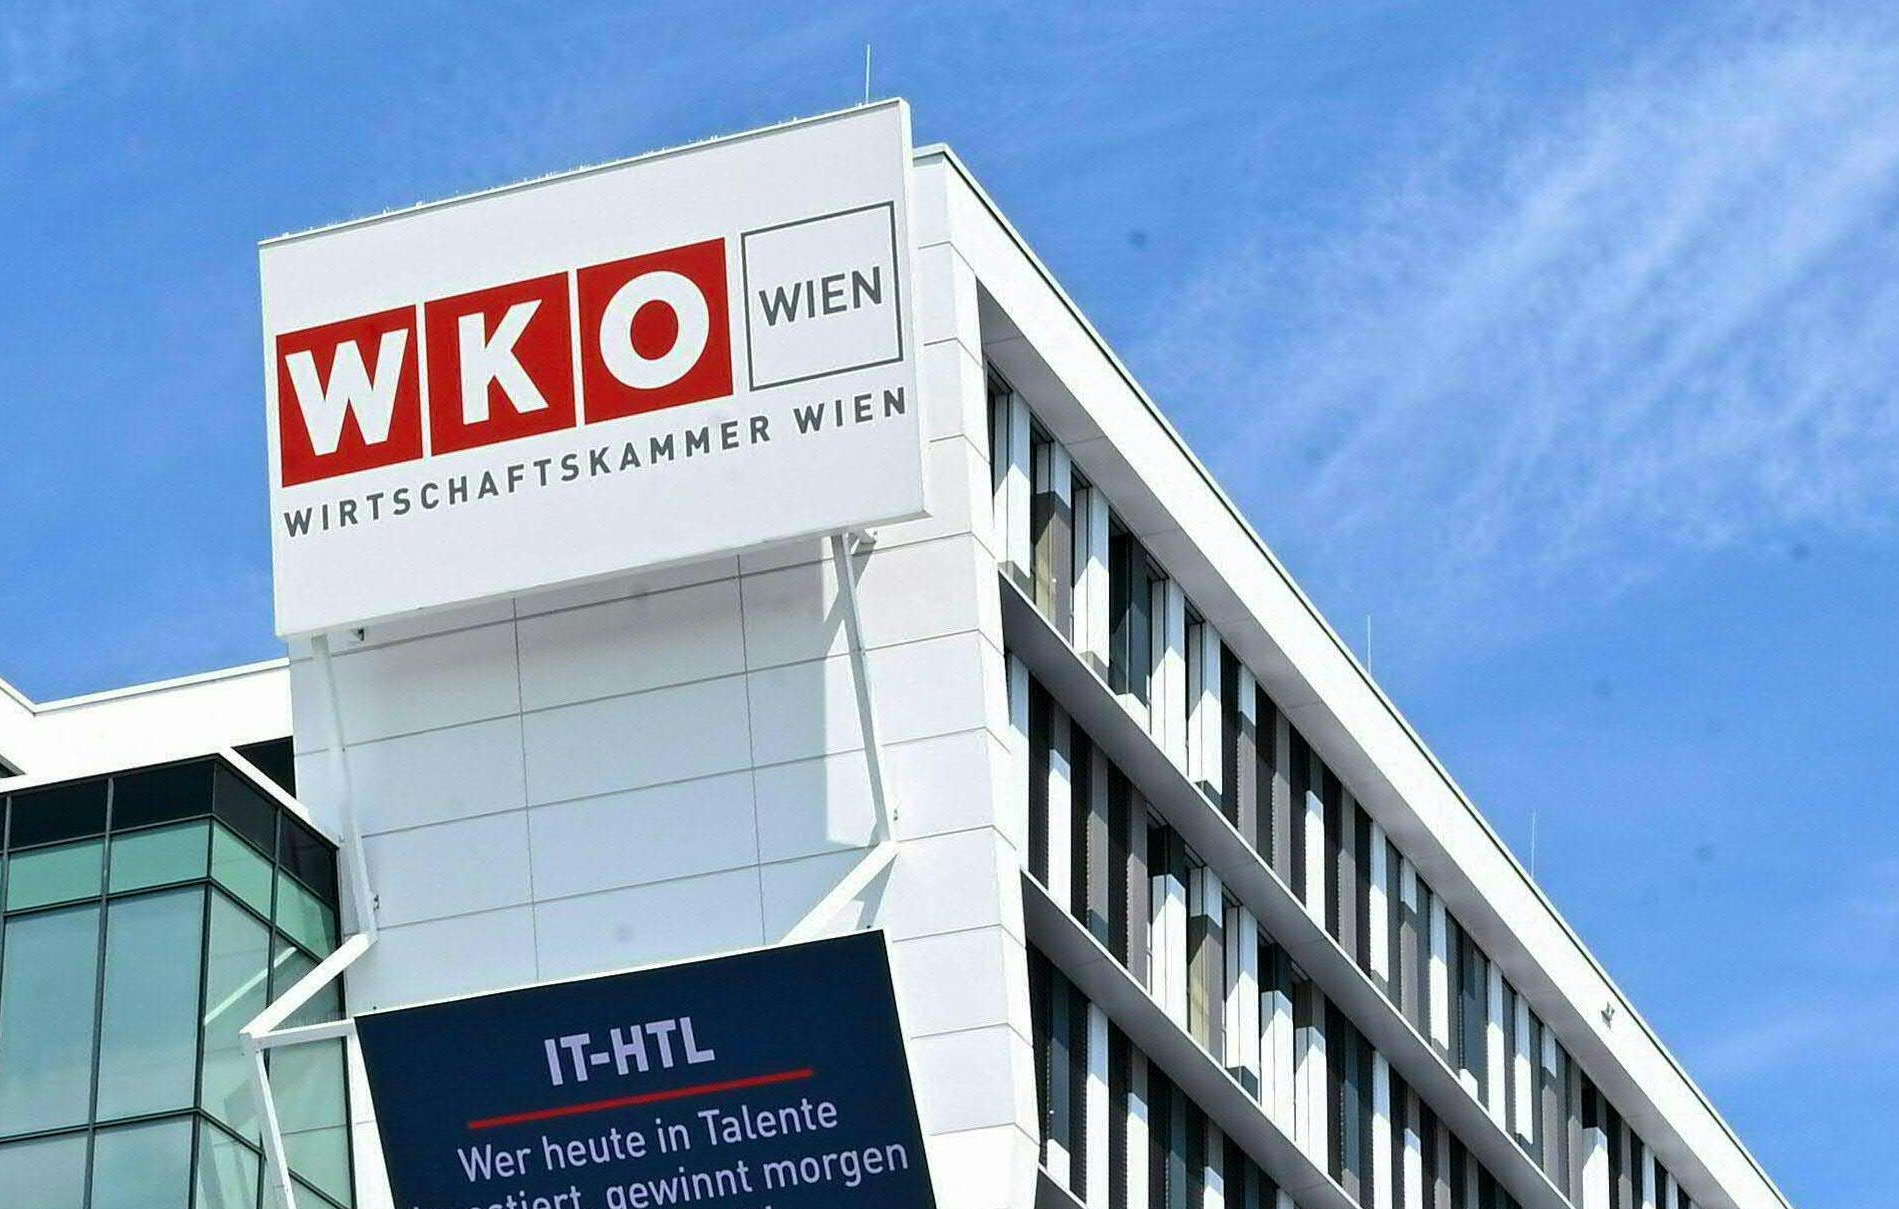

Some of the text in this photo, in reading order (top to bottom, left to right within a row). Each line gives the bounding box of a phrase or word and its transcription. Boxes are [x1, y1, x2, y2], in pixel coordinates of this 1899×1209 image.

[284, 266, 882, 456] WKO WIEN
[284, 386, 907, 538] WIRTSCHAFTSKAMMER WIEN
[544, 1016, 715, 1086] IT-HTL
[458, 1098, 838, 1182] Wer heute in Talente
[763, 1141, 909, 1189] morgen
